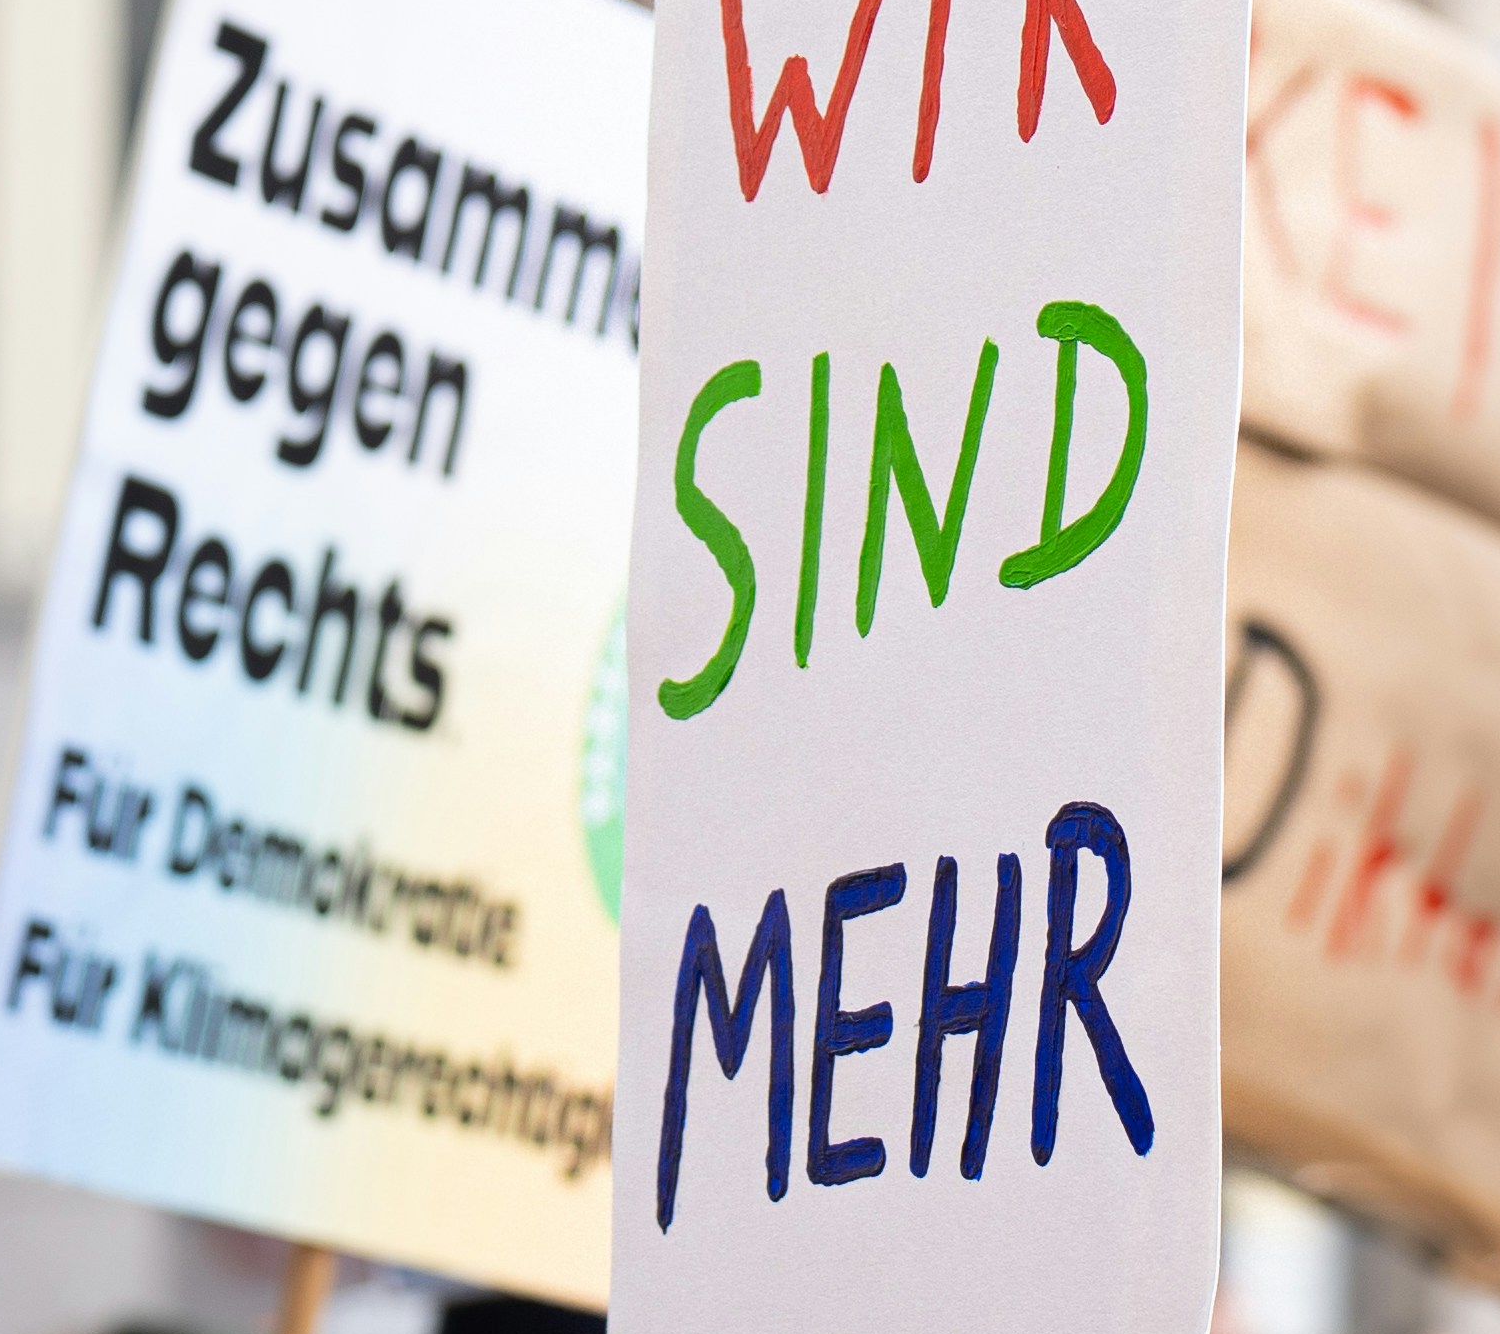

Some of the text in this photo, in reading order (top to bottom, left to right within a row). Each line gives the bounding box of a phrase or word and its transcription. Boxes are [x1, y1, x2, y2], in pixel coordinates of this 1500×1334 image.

[186, 20, 643, 357] Zusamm
[141, 249, 468, 478] gegen
[92, 475, 453, 733] Rechts
[657, 301, 1148, 720] SIND
[5, 917, 122, 1035] Für
[44, 743, 522, 967] Für Demokratie
[658, 803, 1155, 1234] MEHR
